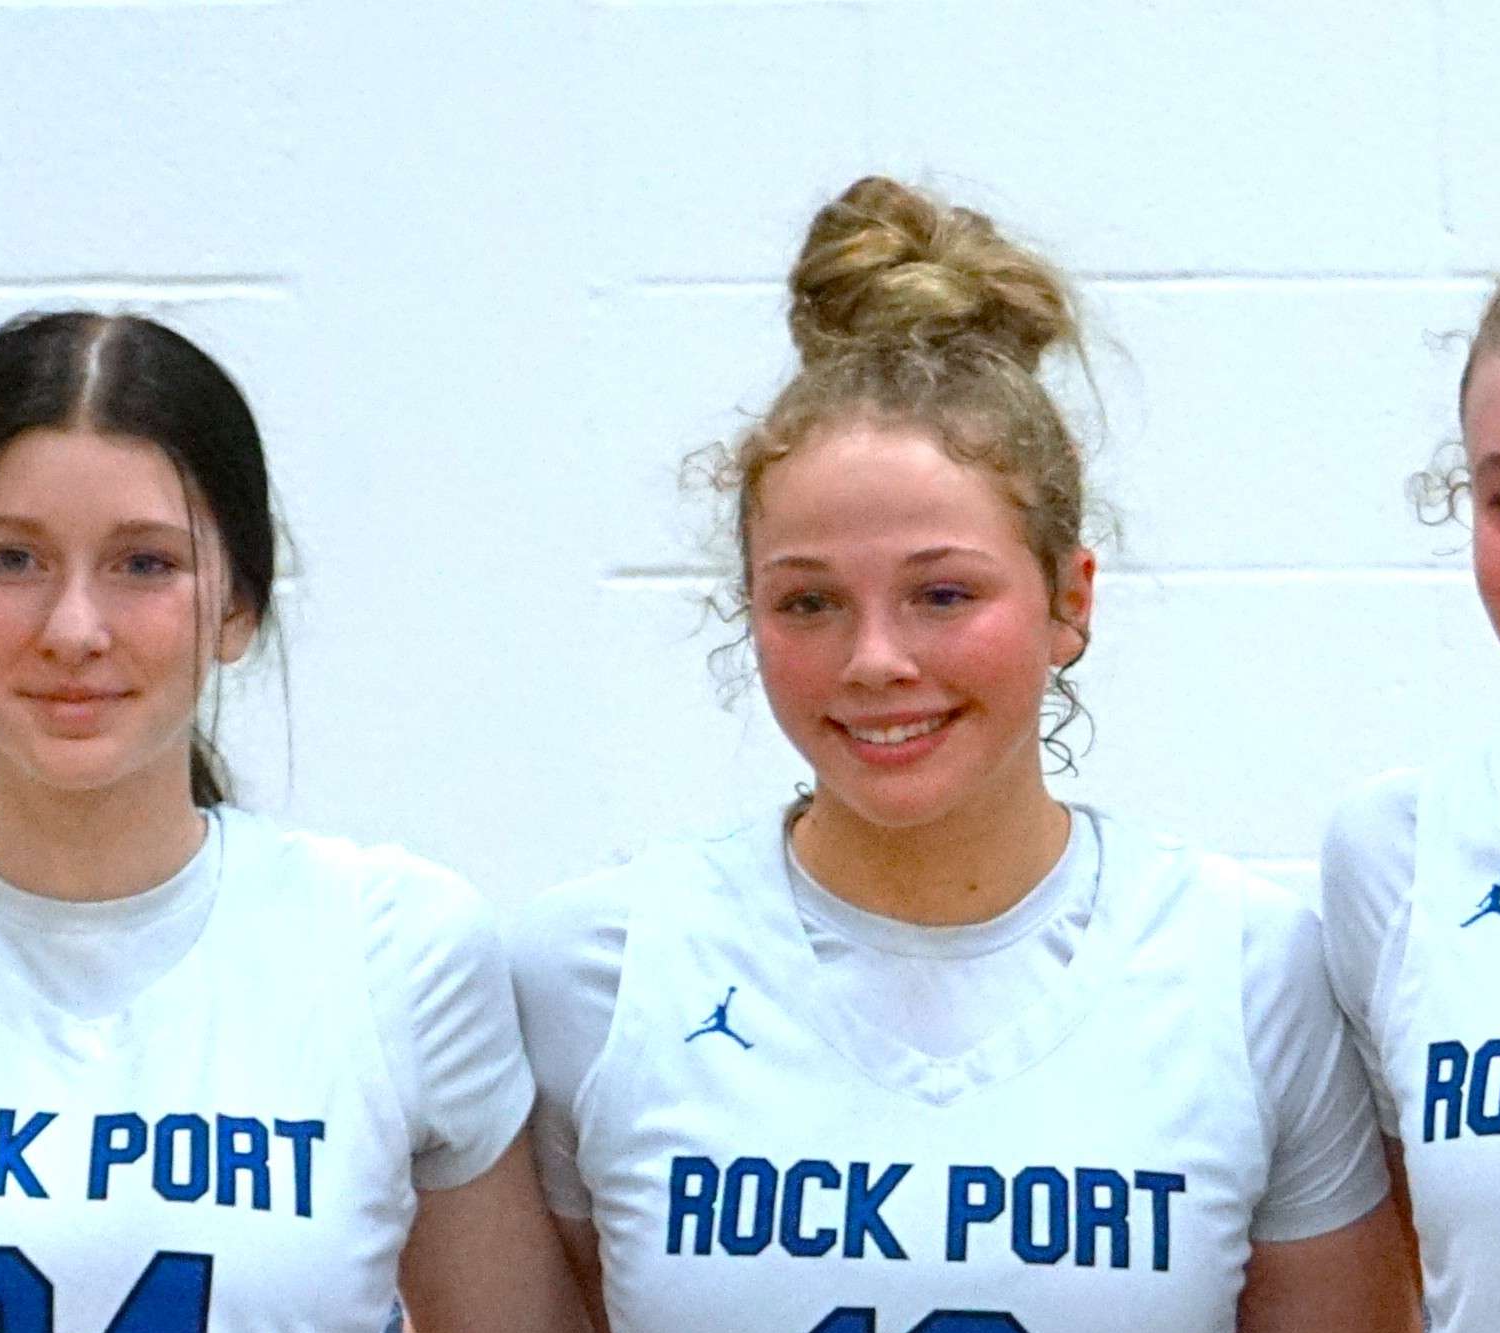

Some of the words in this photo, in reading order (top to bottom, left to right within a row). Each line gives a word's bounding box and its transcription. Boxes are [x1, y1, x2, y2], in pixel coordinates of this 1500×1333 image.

[87, 1112, 325, 1218] PORT
[666, 1156, 913, 1260] ROCK
[946, 1165, 1186, 1272] PORT
